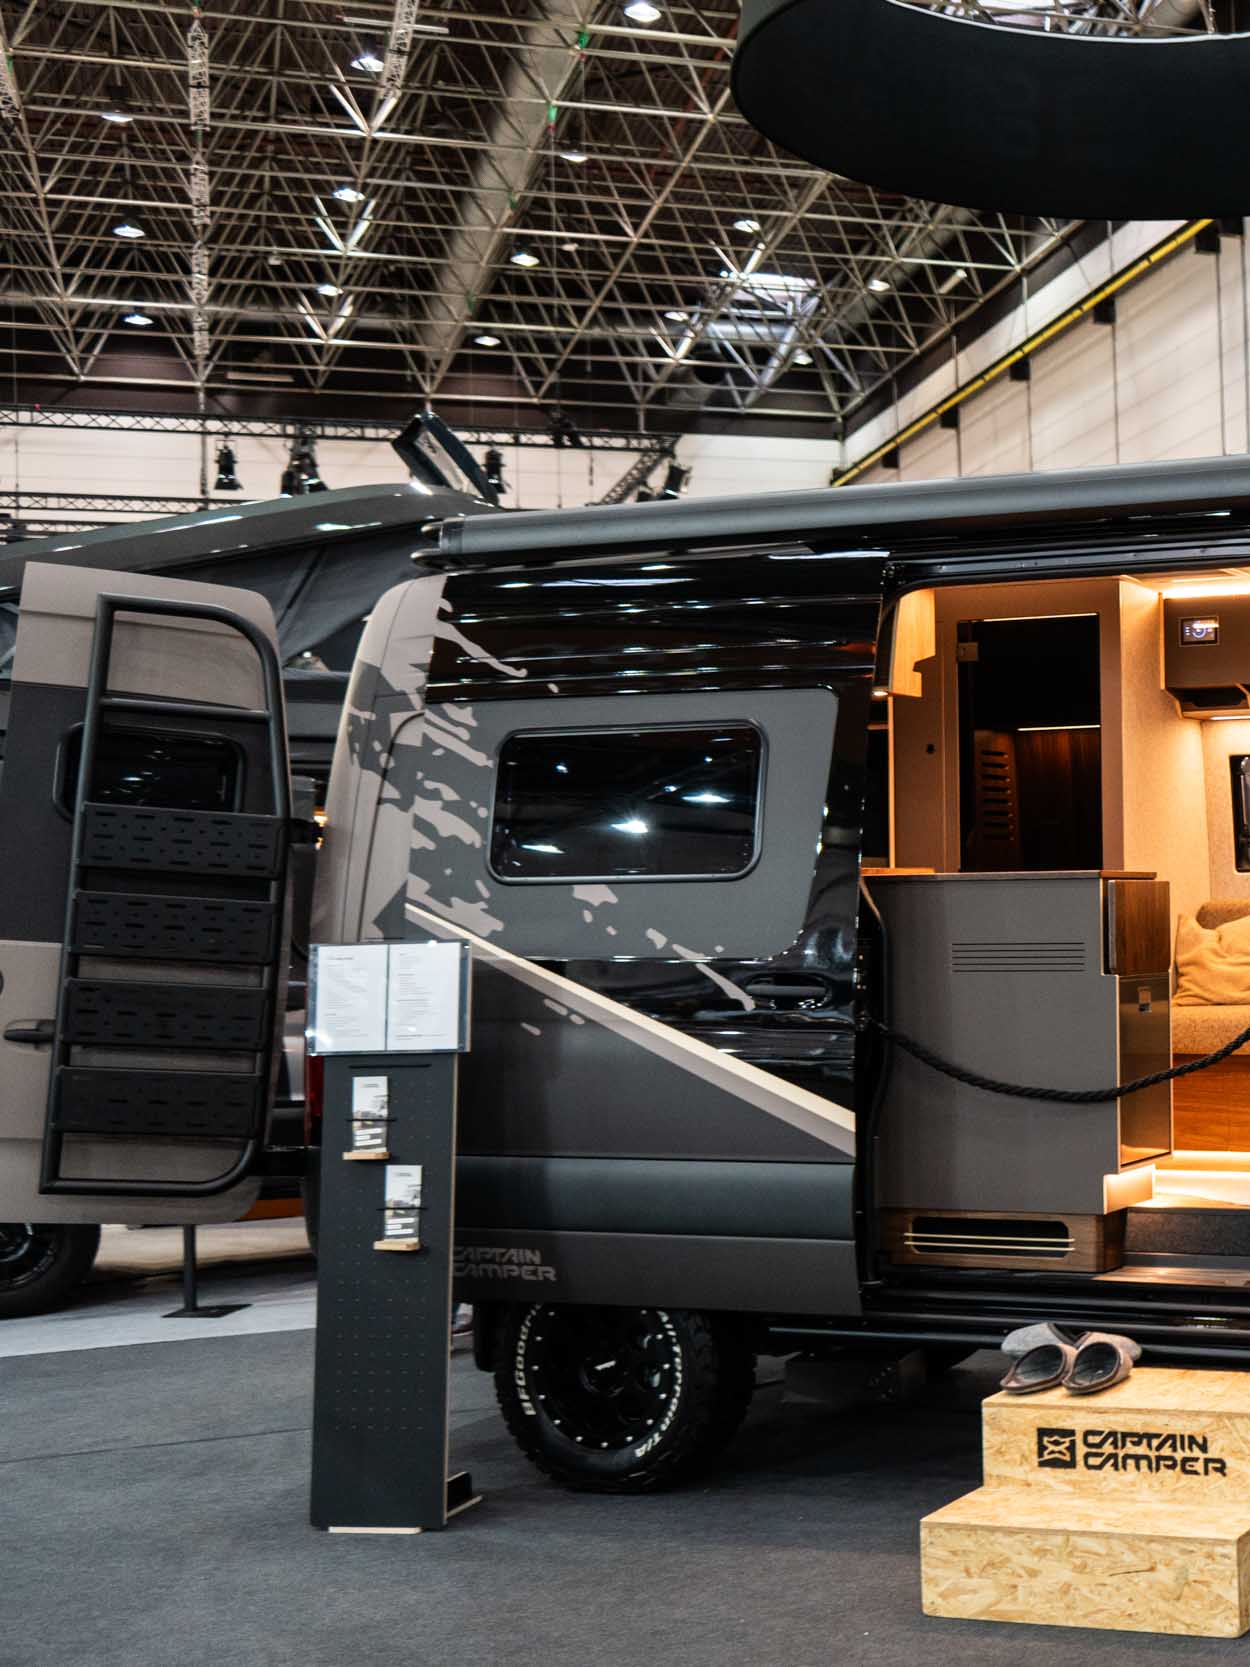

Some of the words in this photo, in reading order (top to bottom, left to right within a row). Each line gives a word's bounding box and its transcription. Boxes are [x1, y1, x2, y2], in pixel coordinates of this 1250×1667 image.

[453, 1247, 542, 1265] CAPTAIN
[453, 1263, 557, 1281] CAMPER
[1083, 1430, 1208, 1454] CAPTAIN
[1084, 1451, 1227, 1477] CAMPER
